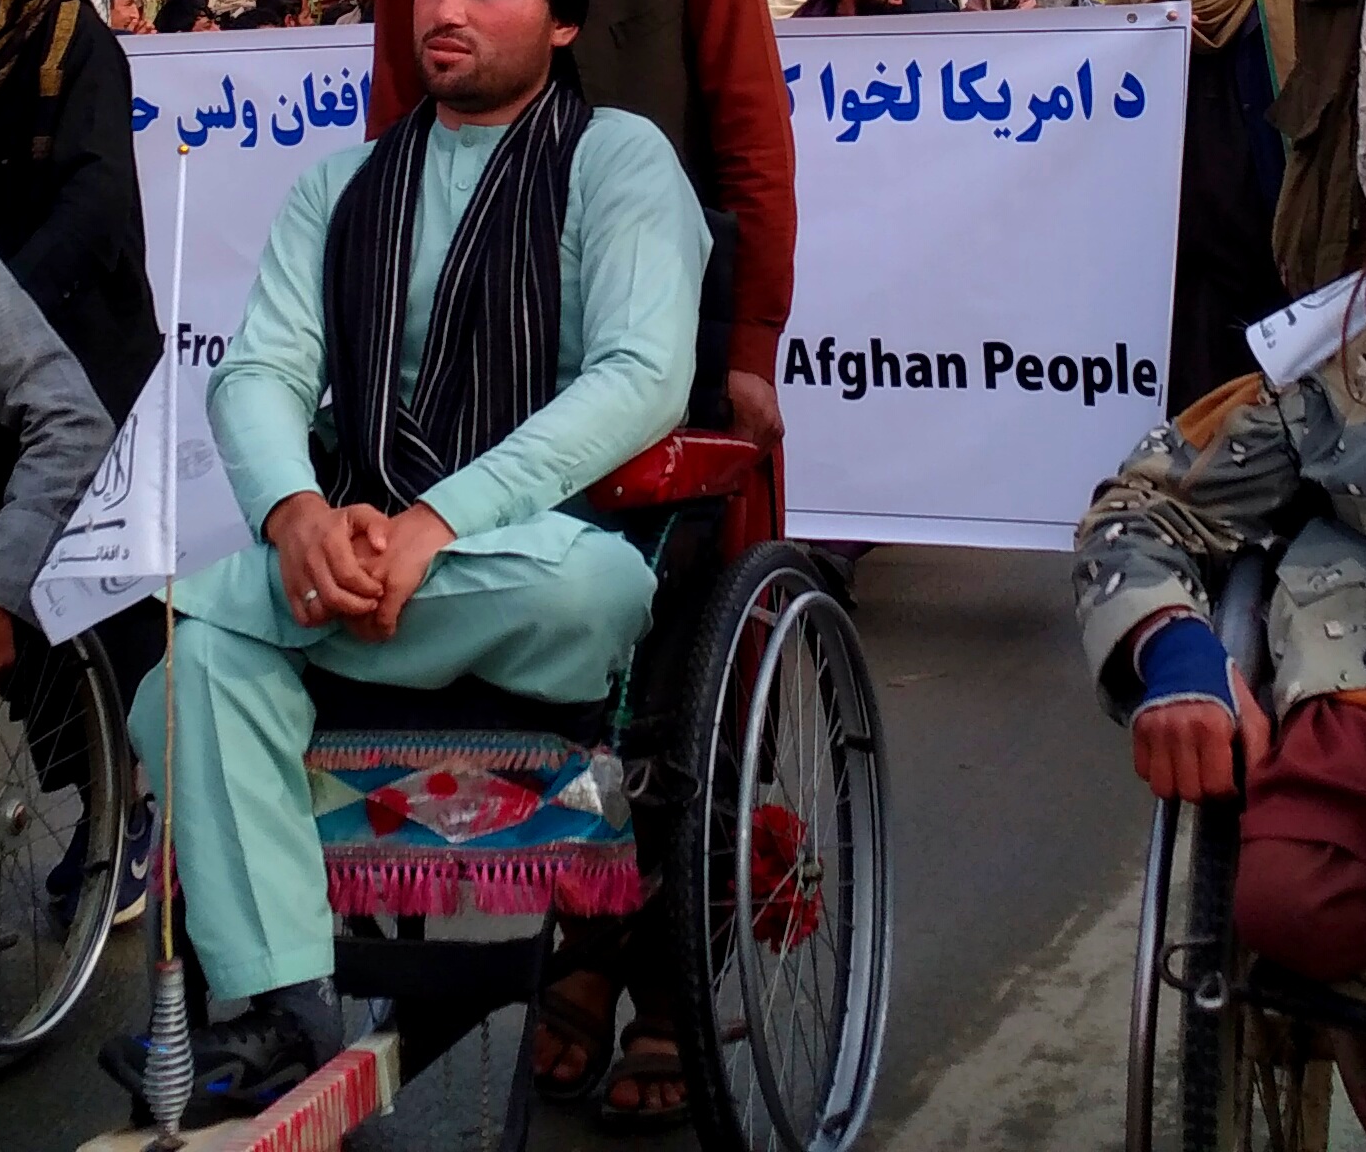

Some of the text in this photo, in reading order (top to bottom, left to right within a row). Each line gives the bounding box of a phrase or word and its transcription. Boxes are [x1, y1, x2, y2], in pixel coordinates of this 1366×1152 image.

[177, 74, 258, 148] ولس
[819, 59, 923, 143] لخوا
[1113, 71, 1146, 120] د
[783, 337, 968, 401] Afghan
